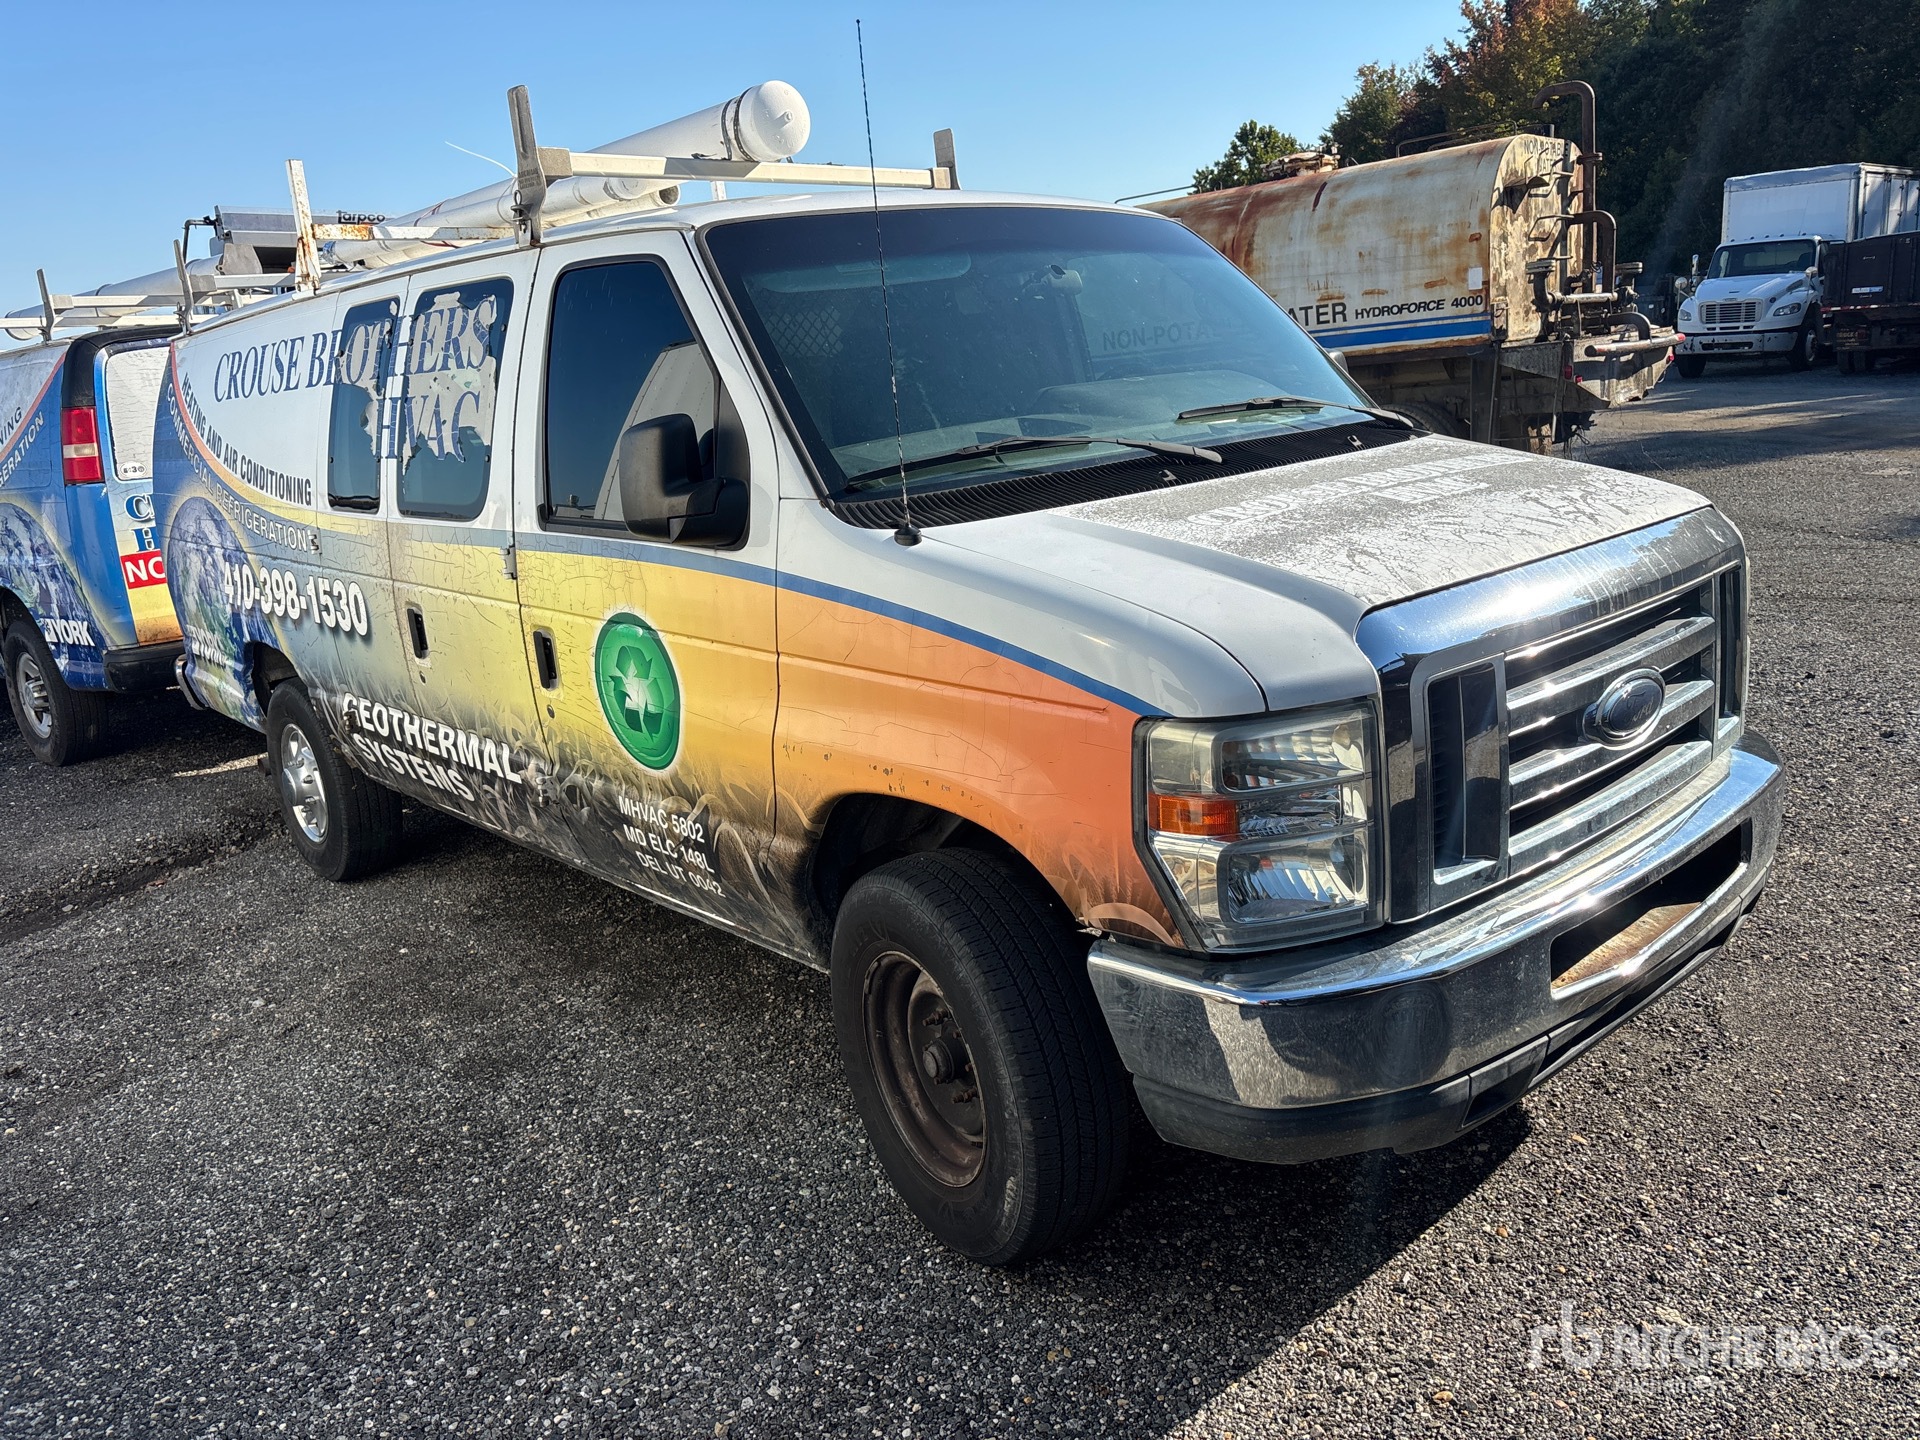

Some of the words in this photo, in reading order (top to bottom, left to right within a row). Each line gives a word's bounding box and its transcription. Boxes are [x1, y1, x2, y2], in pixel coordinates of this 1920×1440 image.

[214, 337, 304, 402] CROUSE
[306, 298, 496, 388] BROTHERS
[1103, 320, 1216, 351] NON-POTA
[1287, 302, 1347, 327] ATER
[1355, 299, 1446, 320] HYDROFORCE
[1451, 295, 1483, 309] 4000
[181, 372, 207, 440] HEATING
[206, 425, 223, 460] AND
[224, 443, 238, 475] AIR
[240, 455, 312, 507] CONDITIONING
[373, 390, 481, 463] HVAC
[167, 383, 214, 496] COMMERCIAL
[216, 482, 308, 553] REFRIGERATION
[55, 618, 96, 647] YORK
[224, 562, 369, 636] 410-398-1530
[343, 692, 522, 784] GEOTHERMAL
[353, 733, 475, 802] SYSTEMS
[619, 796, 668, 829] MHVAC
[671, 814, 705, 843] 5802
[623, 823, 647, 846] MD
[648, 832, 678, 859] ELC
[680, 845, 715, 874] 148L
[635, 851, 668, 875] DEL
[688, 871, 726, 898] 0042
